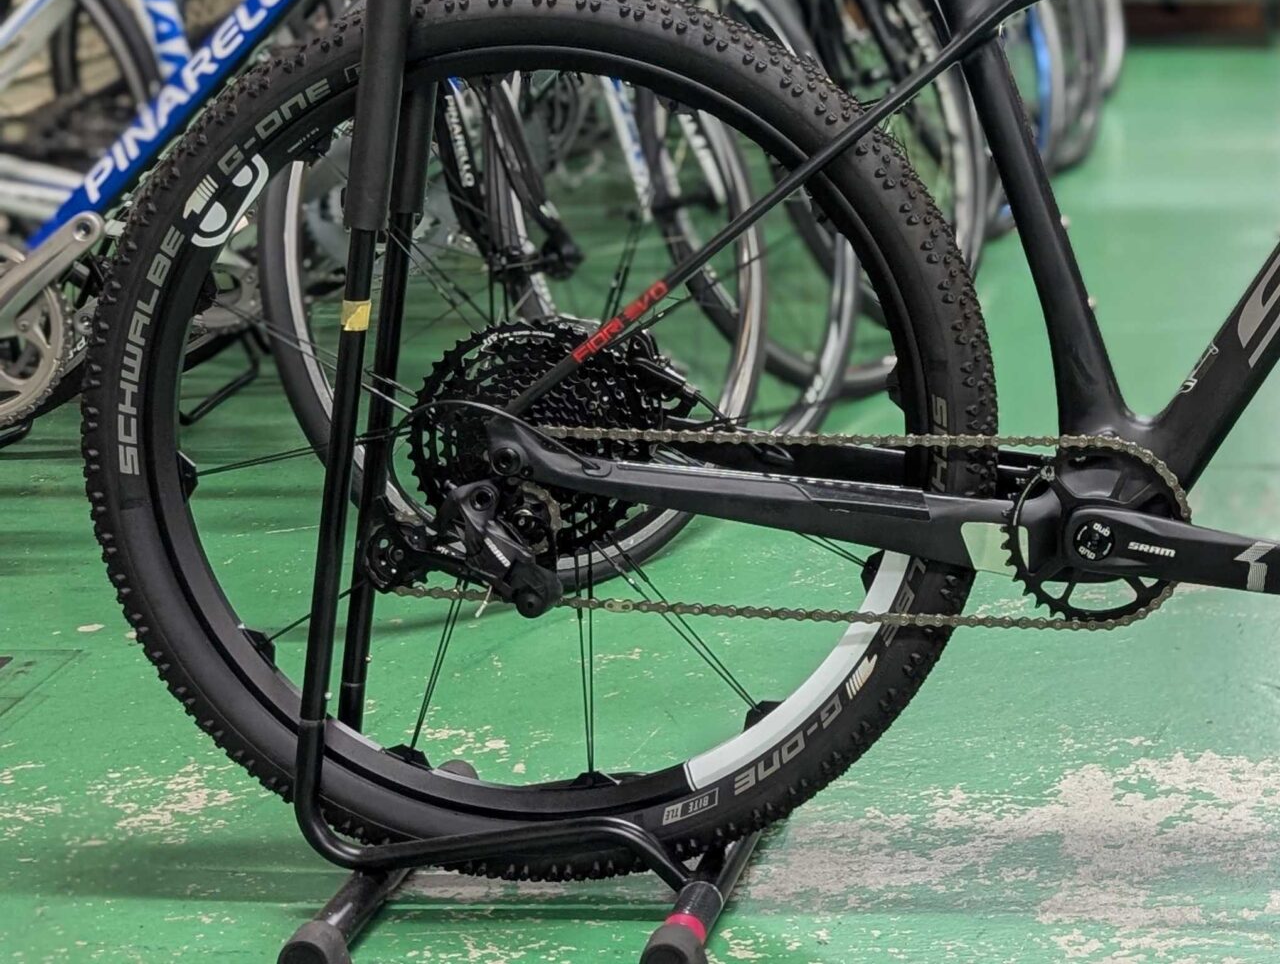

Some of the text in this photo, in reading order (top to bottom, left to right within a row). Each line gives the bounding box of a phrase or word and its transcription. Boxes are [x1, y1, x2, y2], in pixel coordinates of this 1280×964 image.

[118, 77, 332, 476] SCHWALBE G-ONE
[1127, 541, 1177, 558] SRAM
[733, 692, 843, 796] G-ONE
[687, 795, 710, 814] BITE
